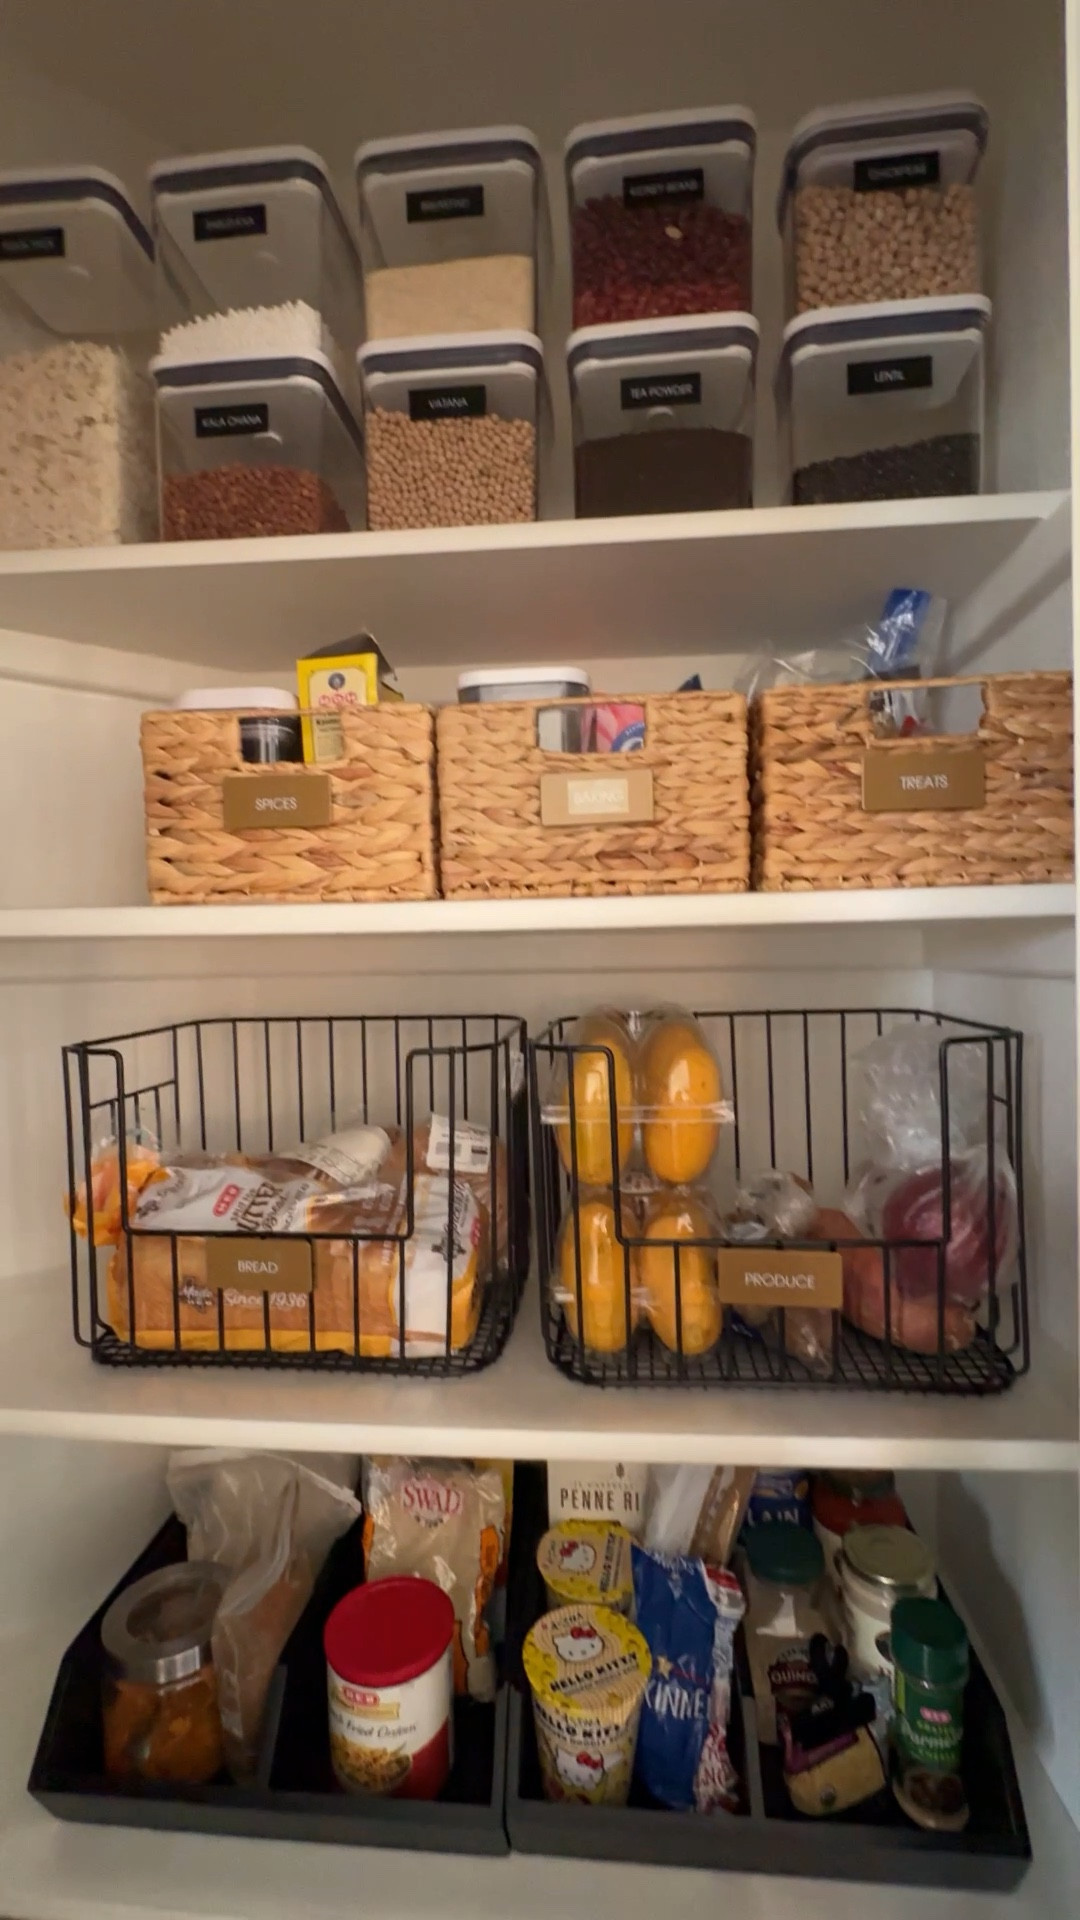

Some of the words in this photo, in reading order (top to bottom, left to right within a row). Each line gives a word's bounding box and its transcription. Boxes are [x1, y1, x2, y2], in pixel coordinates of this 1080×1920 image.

[630, 387, 648, 400] TEA
[648, 383, 693, 398] POWDER
[899, 774, 949, 790] TREATS
[255, 796, 298, 811] SPICES
[236, 1181, 282, 1232] UTTER
[237, 1260, 279, 1274] BREAD
[744, 1272, 815, 1289] PRODUCE
[270, 1291, 307, 1308] 1936
[402, 1485, 462, 1514] SWAD
[560, 1488, 615, 1511] PENNE
[549, 1670, 594, 1692] HELLO
[595, 1651, 638, 1675] KITTY
[771, 1669, 818, 1685] QUINO
[581, 1723, 622, 1738] KITT
